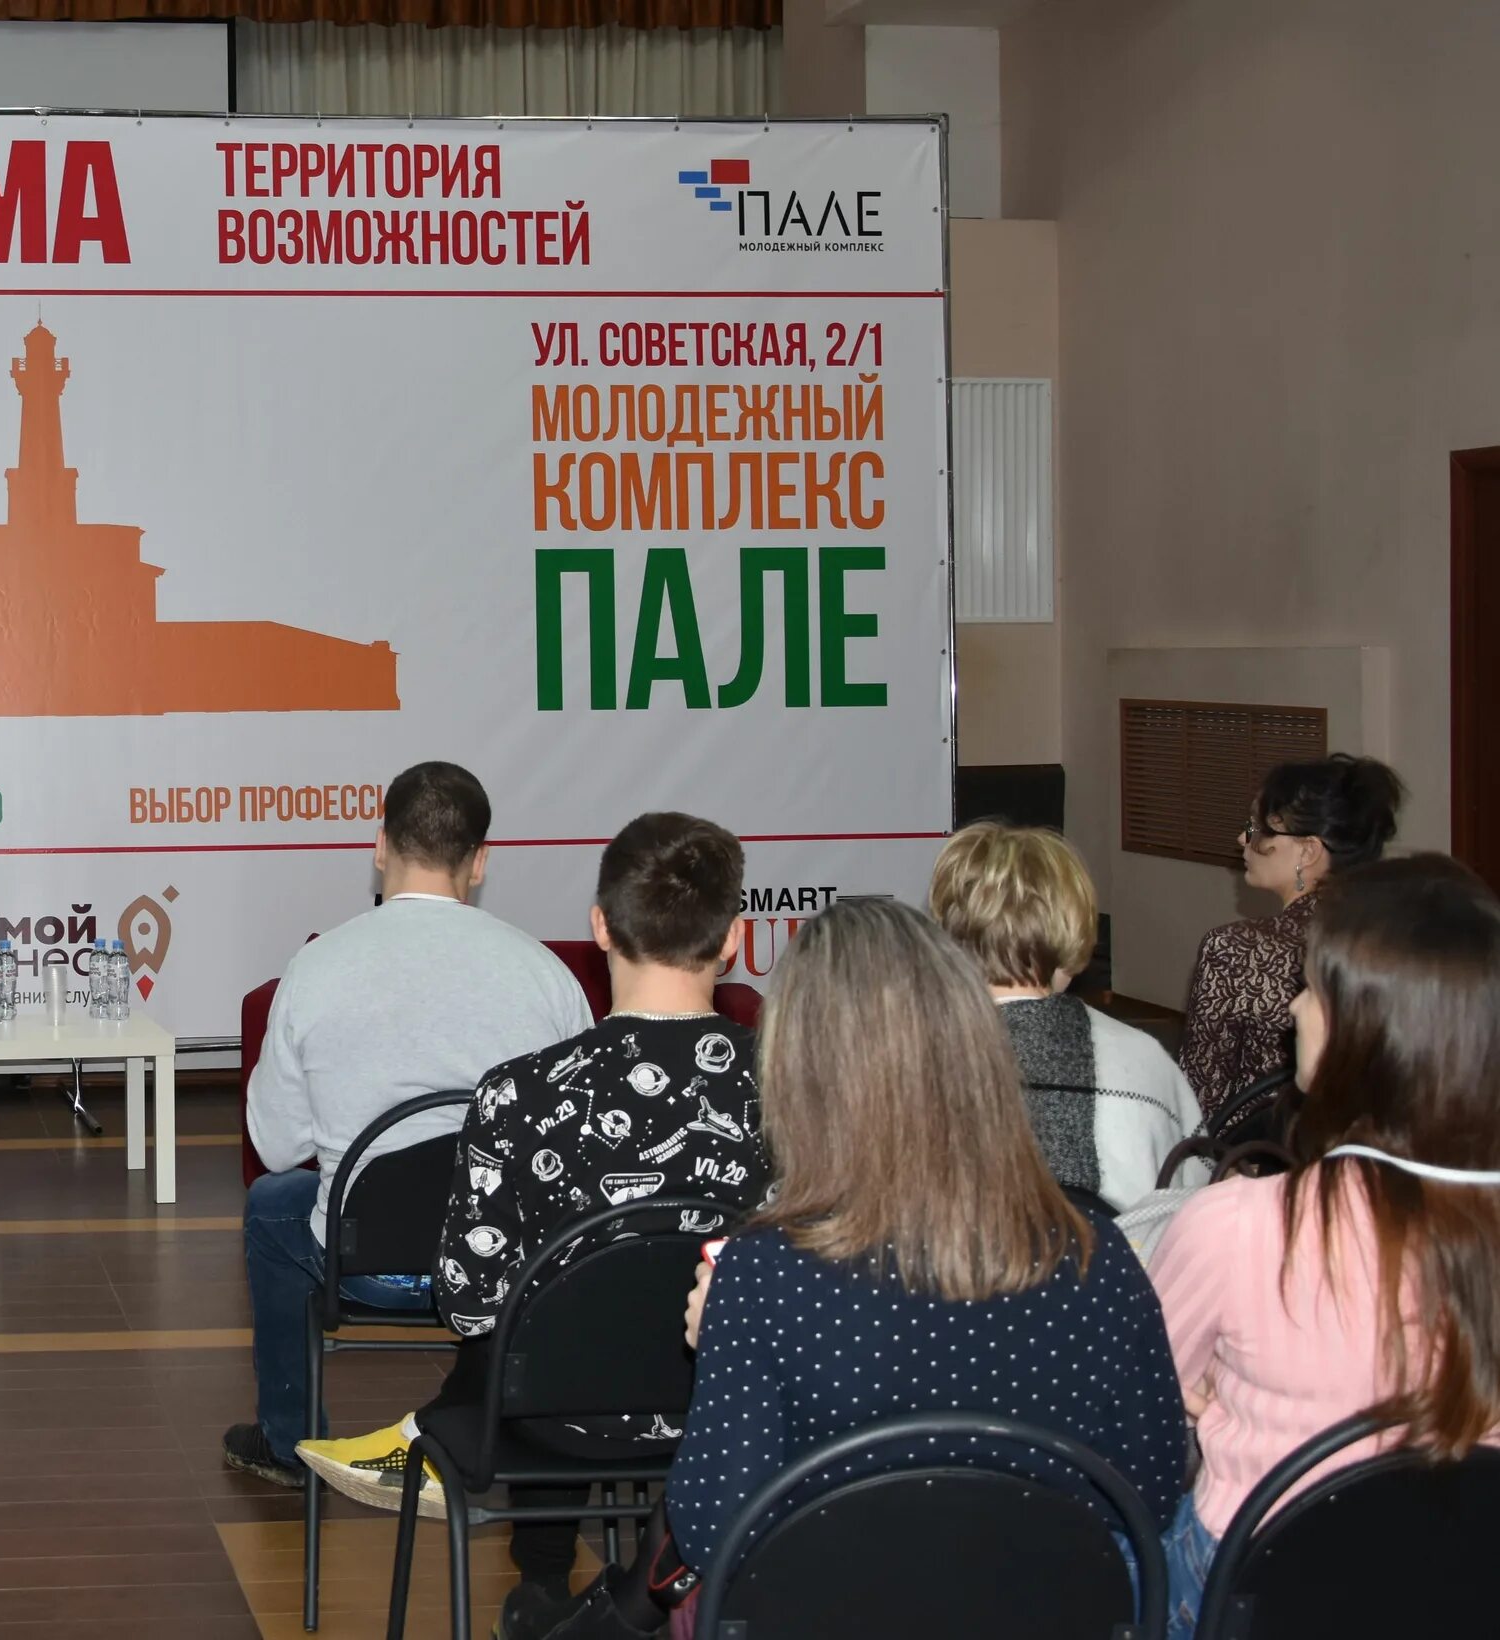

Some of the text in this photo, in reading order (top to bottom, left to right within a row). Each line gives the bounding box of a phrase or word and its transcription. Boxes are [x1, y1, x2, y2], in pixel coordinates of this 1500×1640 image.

[217, 143, 500, 199] ТЕРРИТОРИЯ
[218, 201, 590, 266] ВОЗМОЖНОСТЕЙ
[738, 190, 883, 237] ПАЛЕ
[739, 242, 884, 252] МОЛОДЕЖНЫЙ КОМПЛЕКС
[532, 323, 882, 372] УЛ. СОВЕТСКАЯ, 2/1
[533, 374, 884, 447] МОЛОДЕЖНЫЙ
[534, 450, 885, 532] КОМПЛЕКС
[535, 547, 888, 711] ПАЛЕ
[130, 784, 386, 824] ВЫБОР ПРОФЕСС
